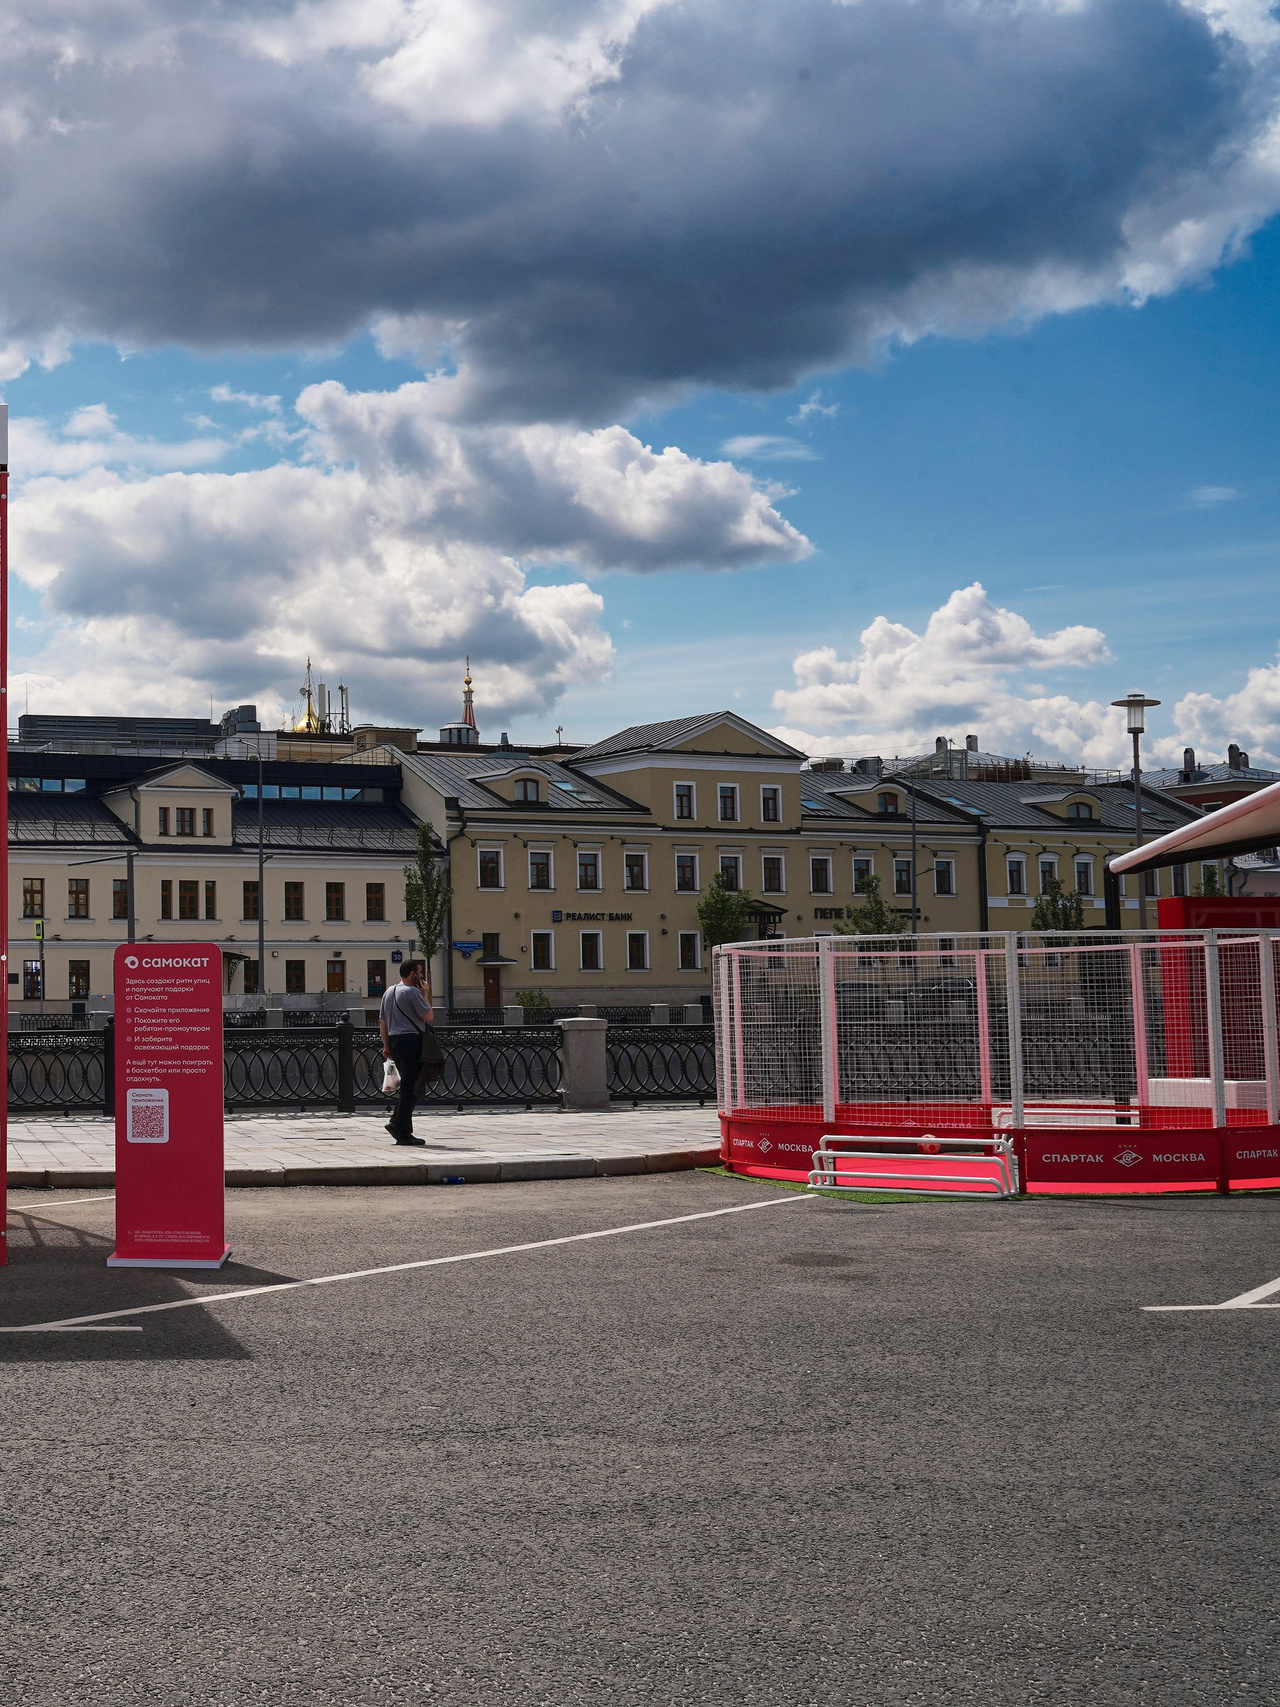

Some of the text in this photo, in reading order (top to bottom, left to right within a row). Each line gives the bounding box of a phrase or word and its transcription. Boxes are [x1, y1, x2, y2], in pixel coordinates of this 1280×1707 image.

[566, 912, 633, 921] РЕАЛИСТ БАНК
[142, 957, 210, 968] самокат
[125, 977, 145, 985] Здесь
[176, 978, 193, 986] ритм
[193, 978, 211, 986] улиц
[165, 986, 194, 994] подарки
[134, 1006, 166, 1014] Скачайте
[141, 1035, 173, 1043] заберите
[732, 1138, 754, 1148] СПАРТАК
[777, 1142, 814, 1152] МОСКВА
[1042, 1152, 1206, 1163] СПАРТАК МОСКВА
[1236, 1149, 1278, 1159] СПАРТАК
